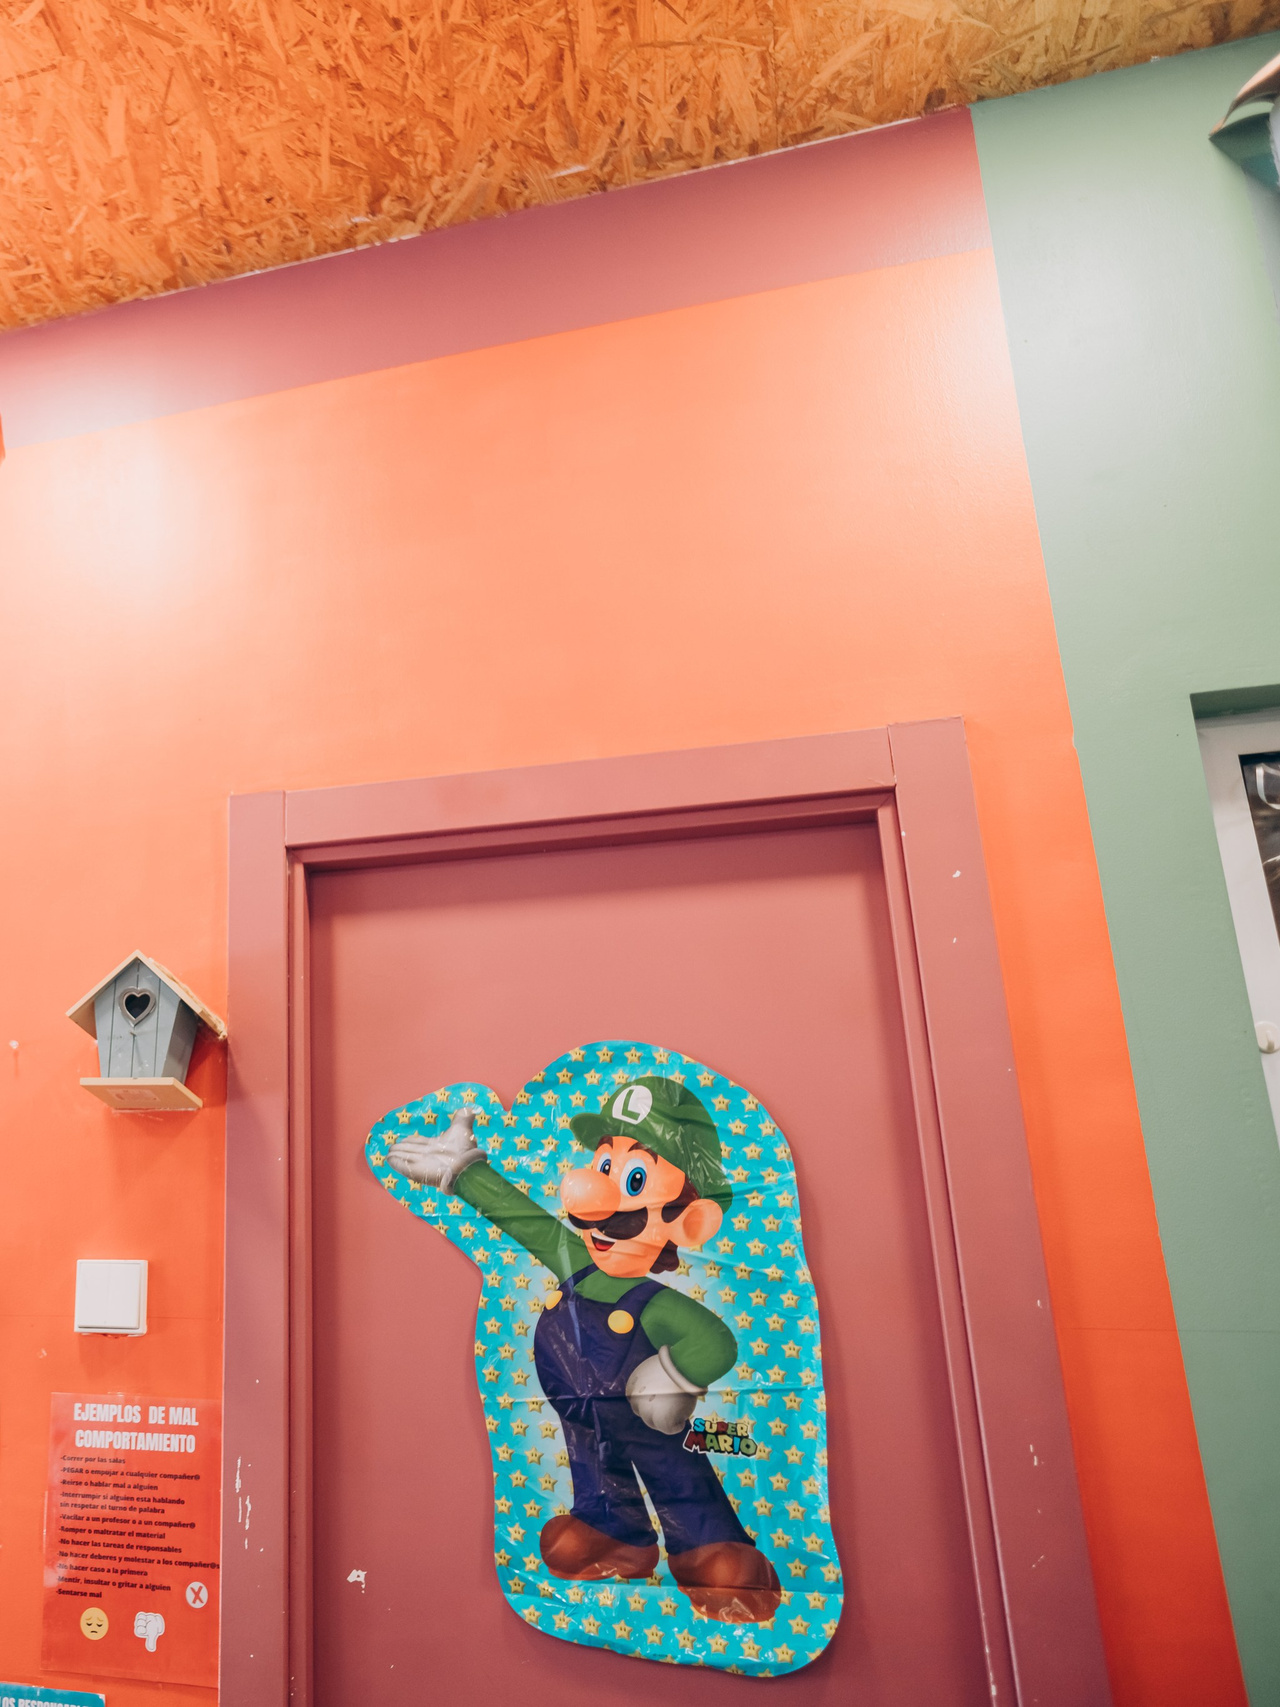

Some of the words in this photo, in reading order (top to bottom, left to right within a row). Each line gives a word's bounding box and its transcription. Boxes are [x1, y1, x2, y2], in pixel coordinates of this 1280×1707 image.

[621, 1088, 641, 1121] L
[73, 1402, 141, 1424] EJEMPLOS
[148, 1405, 166, 1425] DE
[168, 1406, 200, 1426] MAL
[693, 1417, 749, 1437] SUPER
[75, 1429, 196, 1453] COMPORTAMIENTO
[683, 1430, 758, 1457] MARIO
[91, 1469, 119, 1477] empujar
[125, 1470, 158, 1479] cualquier
[159, 1473, 200, 1481] compañer@
[90, 1480, 111, 1488] hablar
[133, 1483, 158, 1491] alguien
[109, 1494, 135, 1502] alguien
[152, 1497, 185, 1505] hablando
[70, 1502, 99, 1510] respetar
[138, 1506, 165, 1514] palabra
[101, 1516, 130, 1524] profesor
[154, 1520, 196, 1529] compañer@
[135, 1531, 166, 1539] material
[102, 1541, 124, 1549] tareas
[135, 1544, 182, 1553] responsables
[69, 1551, 88, 1559] hacer
[89, 1553, 117, 1561] deberes
[123, 1556, 155, 1564] molestar
[174, 1560, 220, 1569] compañer@s
[120, 1568, 148, 1576] primera
[83, 1577, 110, 1586] insultar
[117, 1581, 138, 1589] gritar
[145, 1583, 171, 1592] alguien
